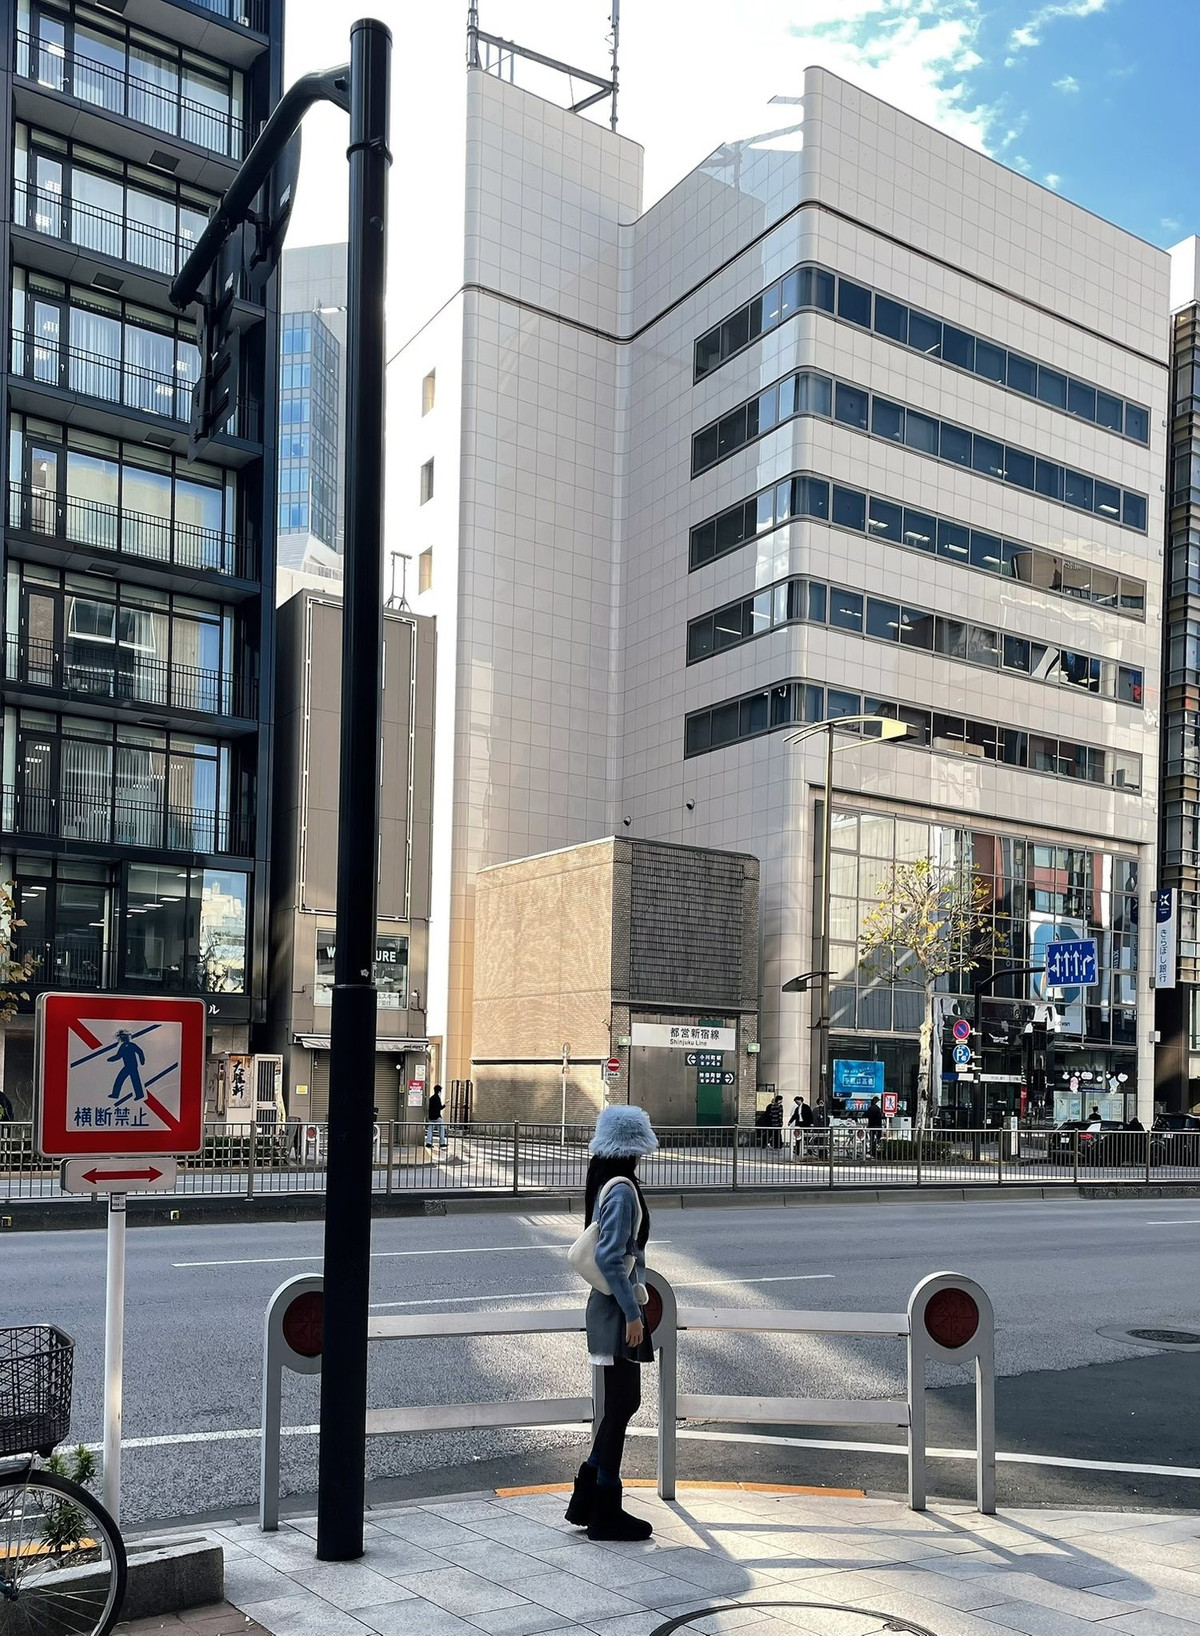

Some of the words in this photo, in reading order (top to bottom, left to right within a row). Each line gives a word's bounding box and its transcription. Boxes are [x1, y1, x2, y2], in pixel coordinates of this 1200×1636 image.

[670, 1027, 720, 1040] 都営新宿線
[670, 1039, 694, 1047] Shinjuku
[74, 1107, 149, 1127] 横断禁止
